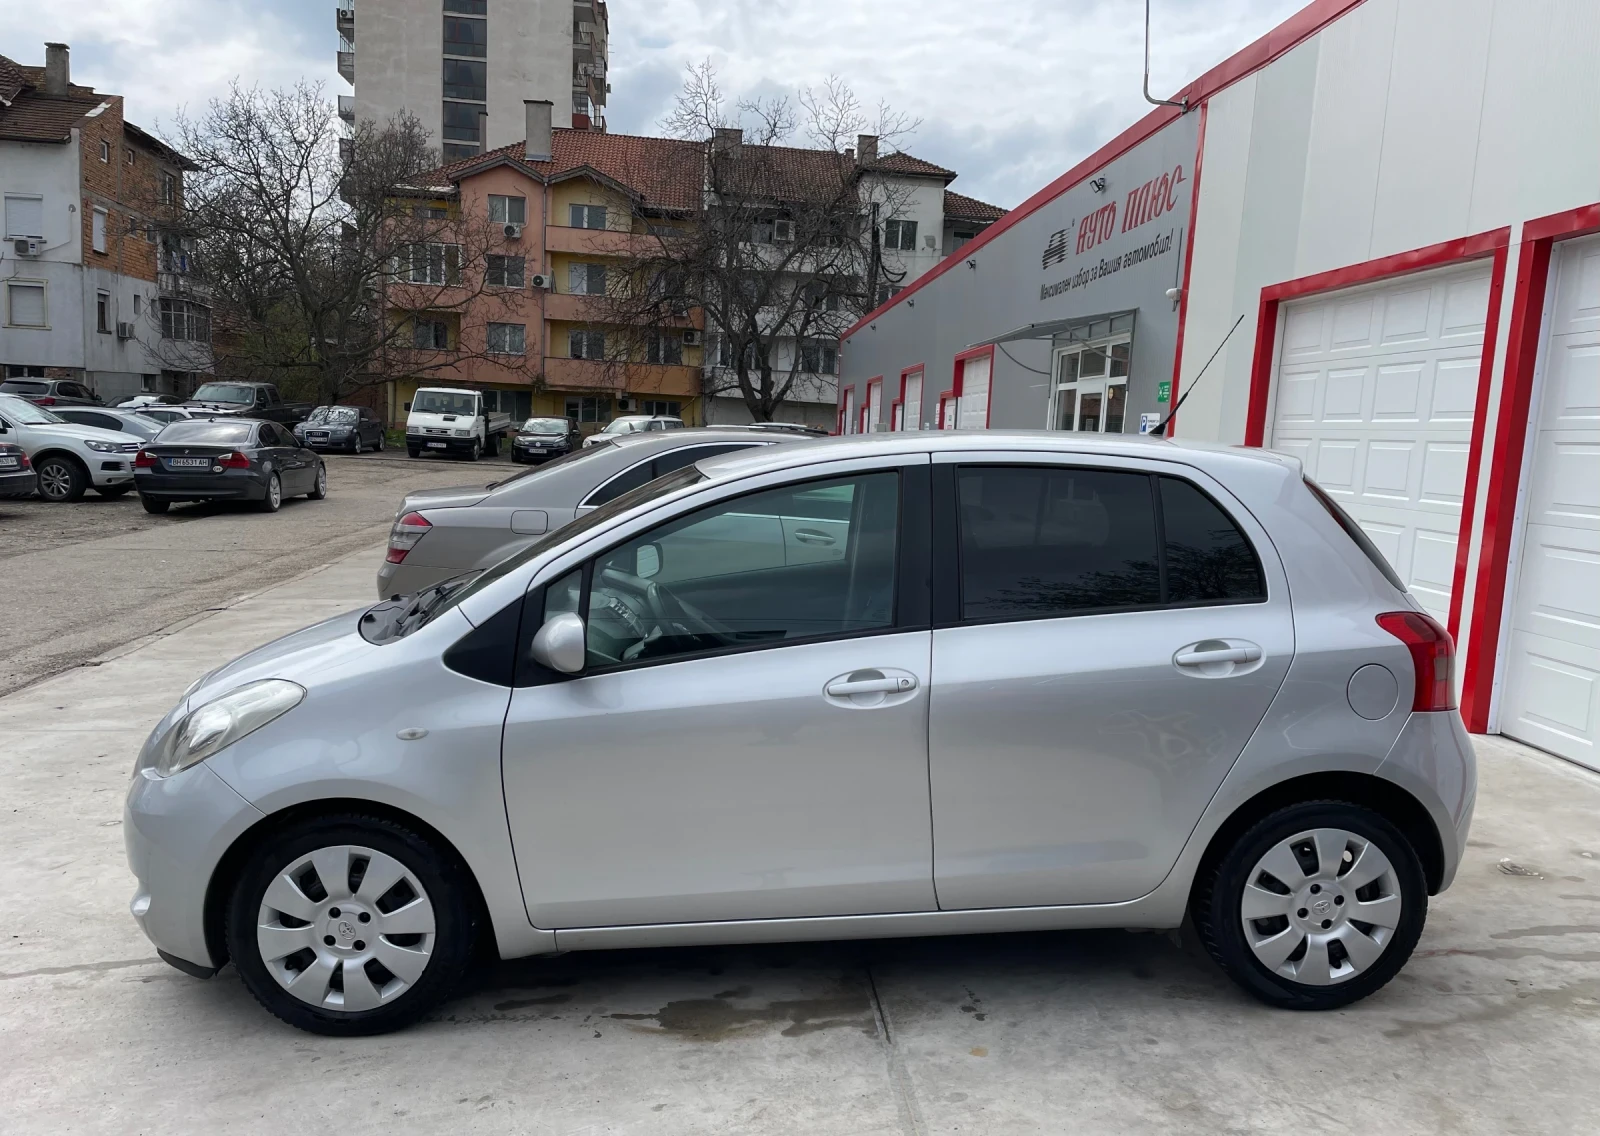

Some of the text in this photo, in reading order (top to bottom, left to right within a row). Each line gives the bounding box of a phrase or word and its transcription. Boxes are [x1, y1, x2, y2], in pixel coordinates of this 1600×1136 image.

[1076, 164, 1187, 255] АУТО ПЛЮС
[1072, 267, 1089, 289] избор
[1090, 266, 1098, 282] за
[1098, 258, 1122, 279] Вашия
